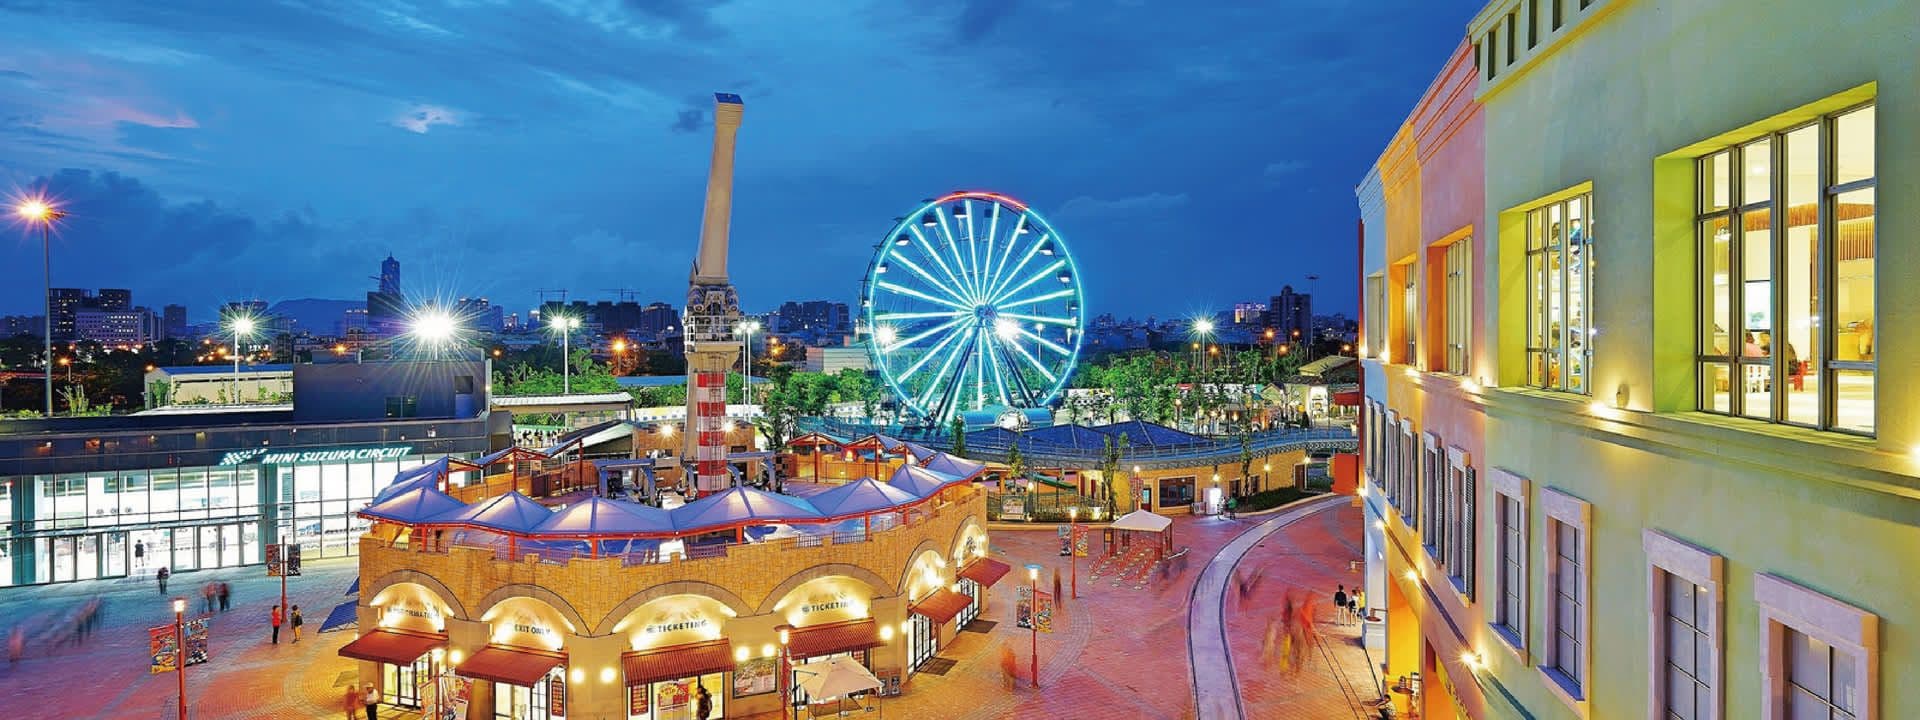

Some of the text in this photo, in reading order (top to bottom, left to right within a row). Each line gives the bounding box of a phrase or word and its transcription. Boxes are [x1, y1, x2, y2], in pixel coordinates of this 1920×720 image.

[262, 446, 413, 465] MINI SUZUKA CIRCUIT
[811, 600, 855, 612] TICKETIN
